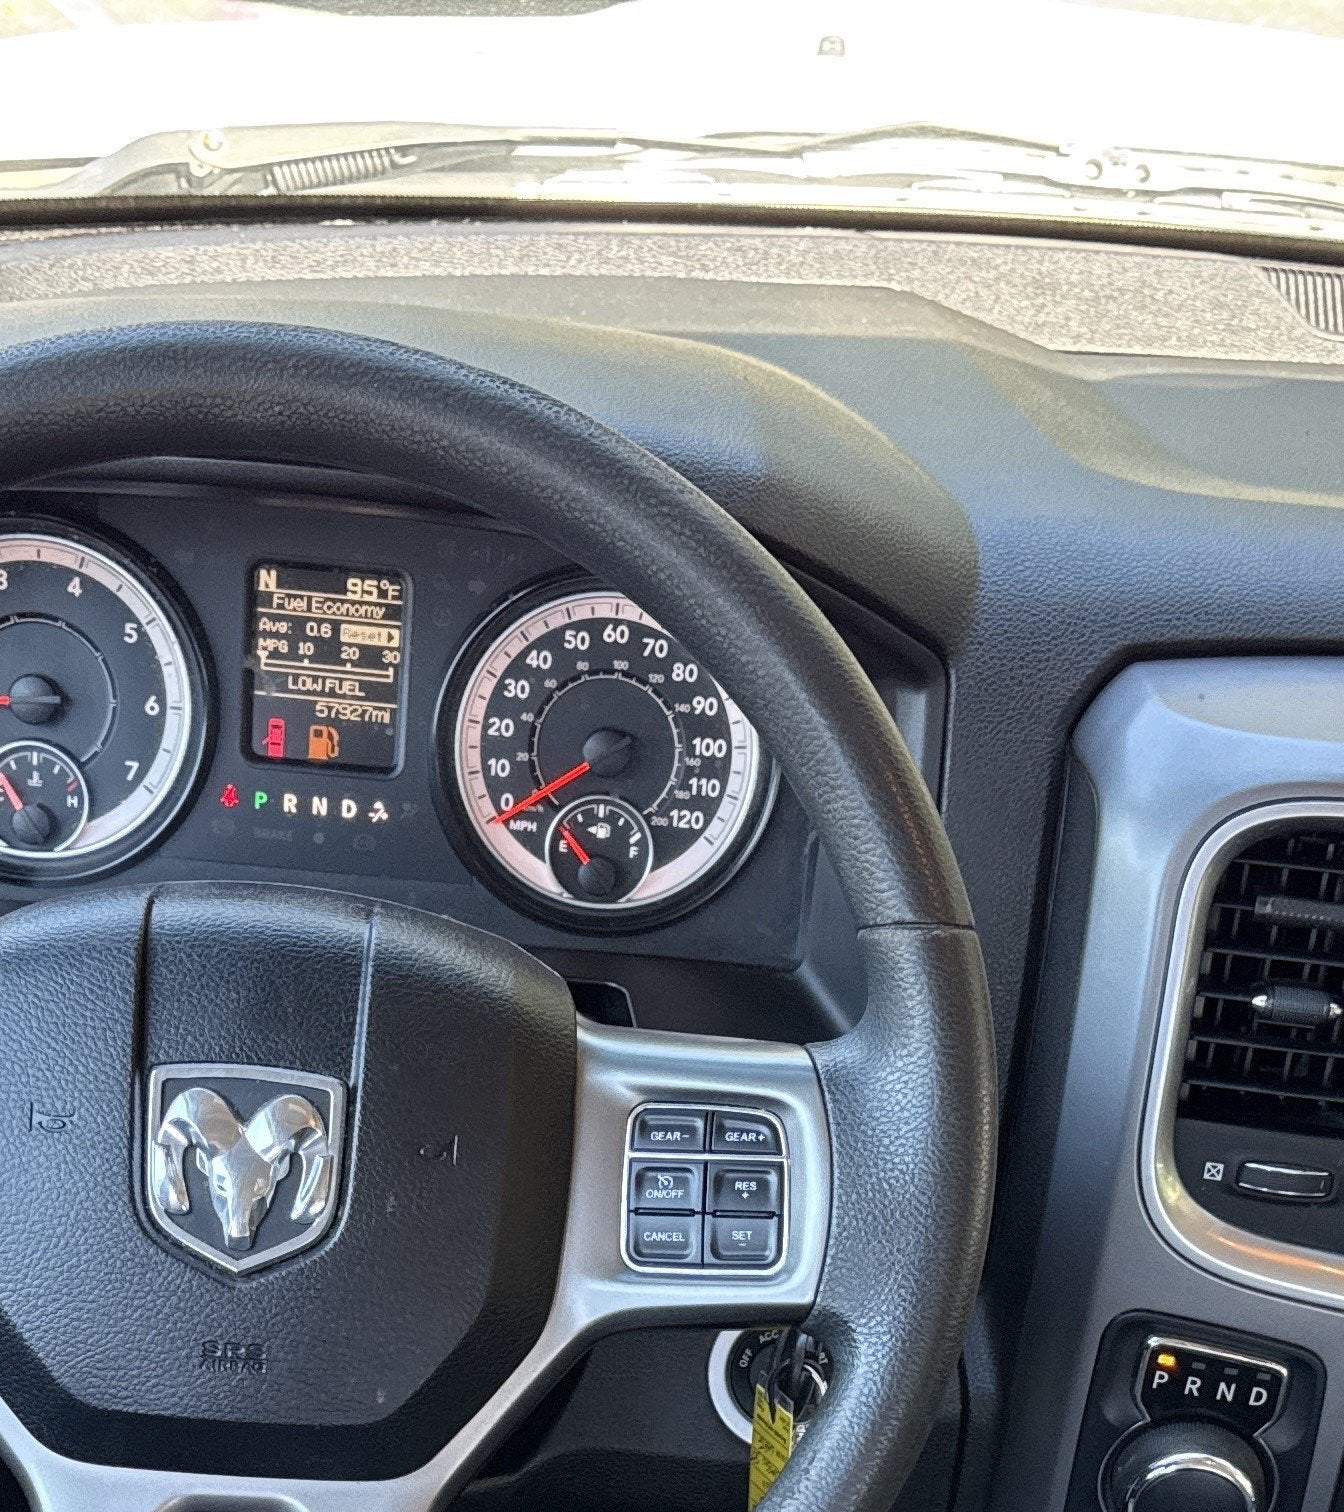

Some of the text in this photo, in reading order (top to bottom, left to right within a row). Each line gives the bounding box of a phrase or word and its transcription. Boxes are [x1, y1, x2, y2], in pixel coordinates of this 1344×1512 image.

[67, 577, 82, 597] 4
[258, 569, 277, 589] N
[273, 593, 386, 619] Fuel Economy
[124, 623, 138, 643] 5
[306, 621, 332, 638] 0.6
[603, 625, 630, 644] 60
[258, 637, 289, 653] MPG
[298, 641, 315, 656] 10
[564, 630, 590, 650] 50
[642, 638, 668, 658] 70
[340, 646, 360, 660] 20
[382, 650, 401, 664] 30
[525, 650, 552, 670] 40
[613, 660, 629, 670] 100
[672, 663, 699, 682] 80
[288, 675, 366, 696] LOW FUEL
[504, 680, 529, 699] 30
[544, 678, 557, 689] 60
[145, 696, 160, 716] 6
[692, 696, 718, 716] 90
[520, 712, 534, 722] 40
[487, 719, 514, 738] 20
[516, 752, 529, 762] 20
[692, 737, 727, 758] 100
[125, 762, 139, 781] 7
[487, 759, 511, 778] 10
[689, 777, 720, 797] 110
[67, 795, 78, 808] H
[255, 790, 357, 818] P R N D
[500, 792, 514, 811] 0
[509, 820, 537, 832] MPH
[669, 808, 704, 830] 120
[559, 840, 568, 853] E
[629, 846, 638, 858] F
[646, 1189, 684, 1199] ON/OFF
[734, 1181, 757, 1191] RES
[643, 1231, 685, 1242] CANCEL
[731, 1230, 752, 1241] SET
[758, 1329, 780, 1344] ACC
[739, 1347, 753, 1368] OFF
[1152, 1370, 1268, 1406] P R N D
